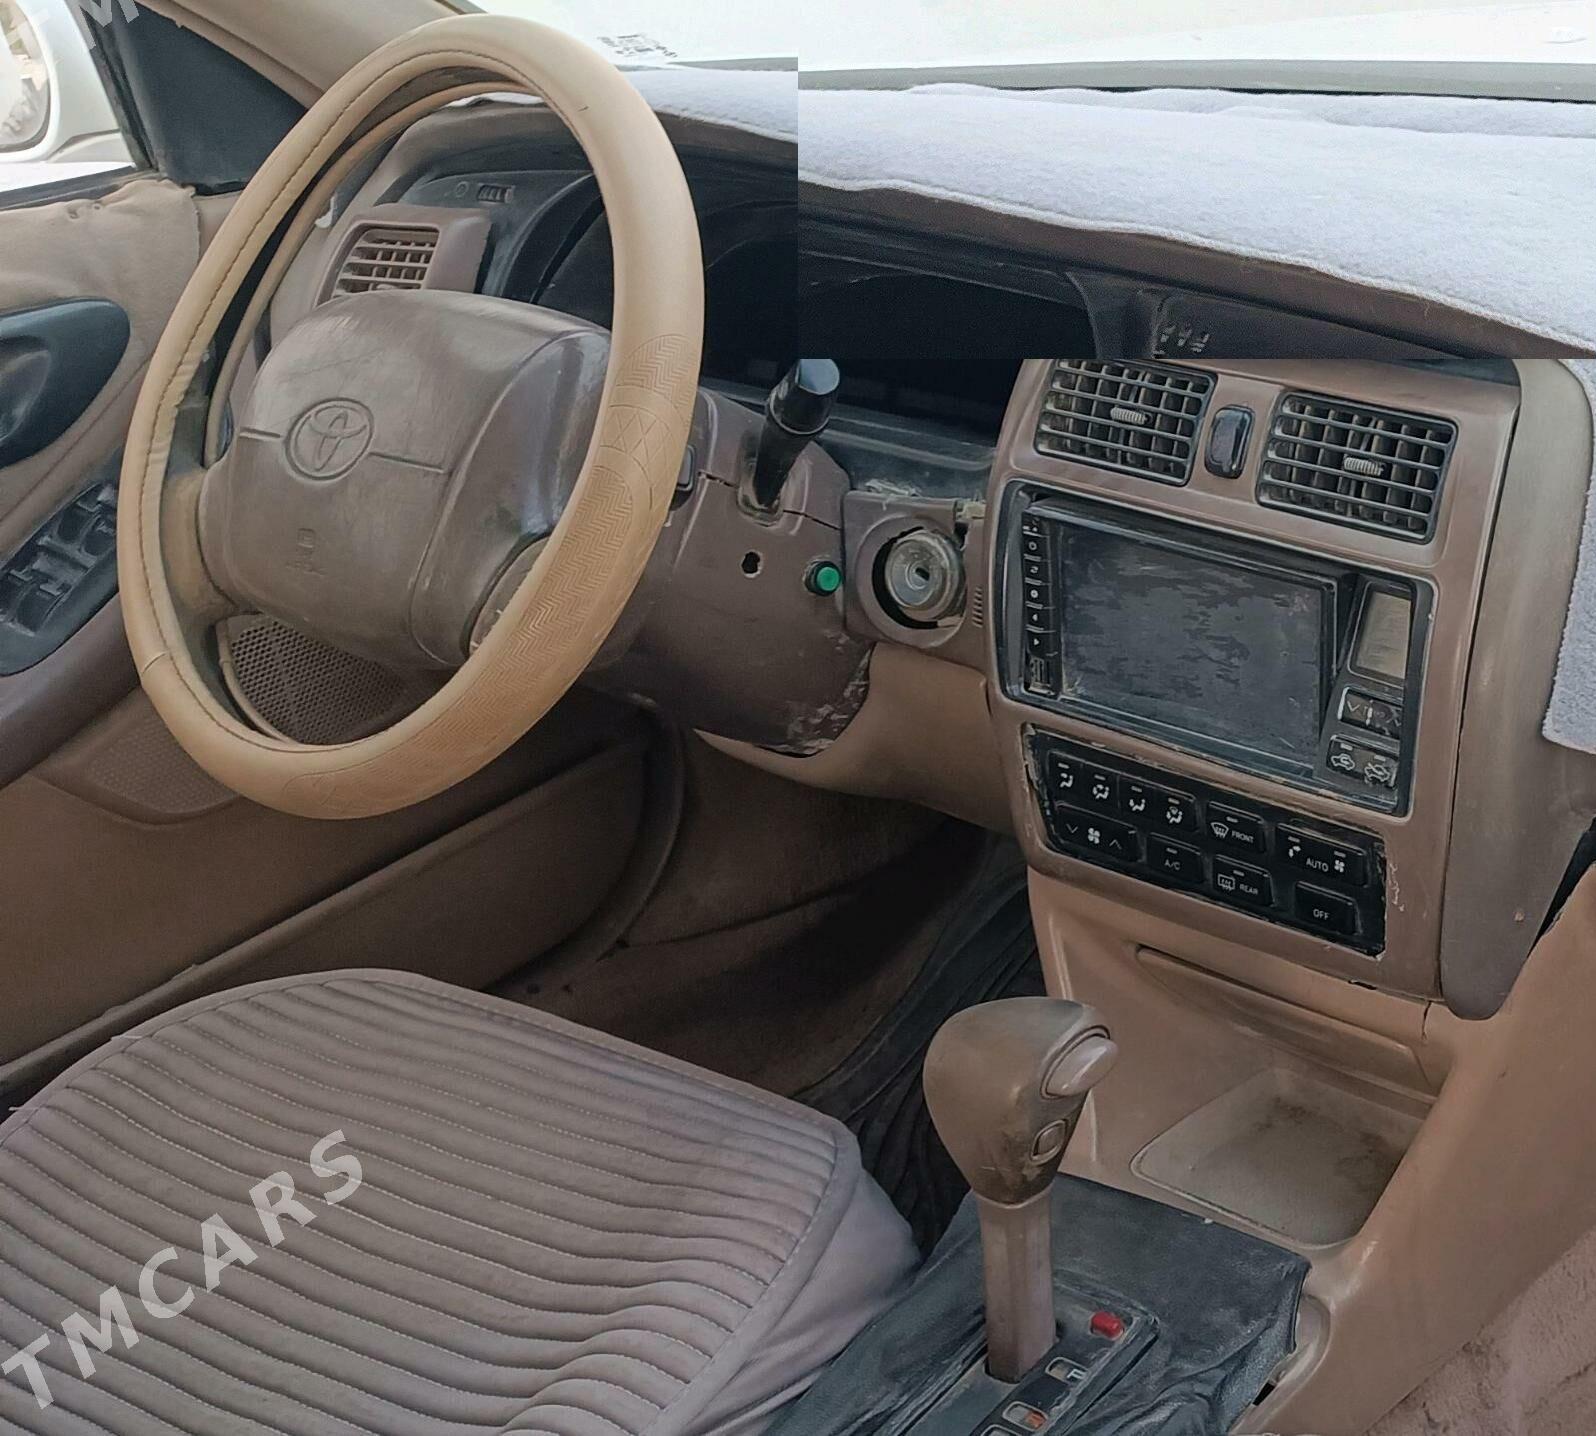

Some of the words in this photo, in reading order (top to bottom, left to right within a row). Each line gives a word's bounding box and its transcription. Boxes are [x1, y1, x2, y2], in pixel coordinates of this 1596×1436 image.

[1231, 829, 1255, 843] FRONT
[1164, 859, 1181, 871] A/C
[1306, 857, 1329, 872] AUTO
[1239, 883, 1259, 896] REAR
[1313, 908, 1330, 920] OFF
